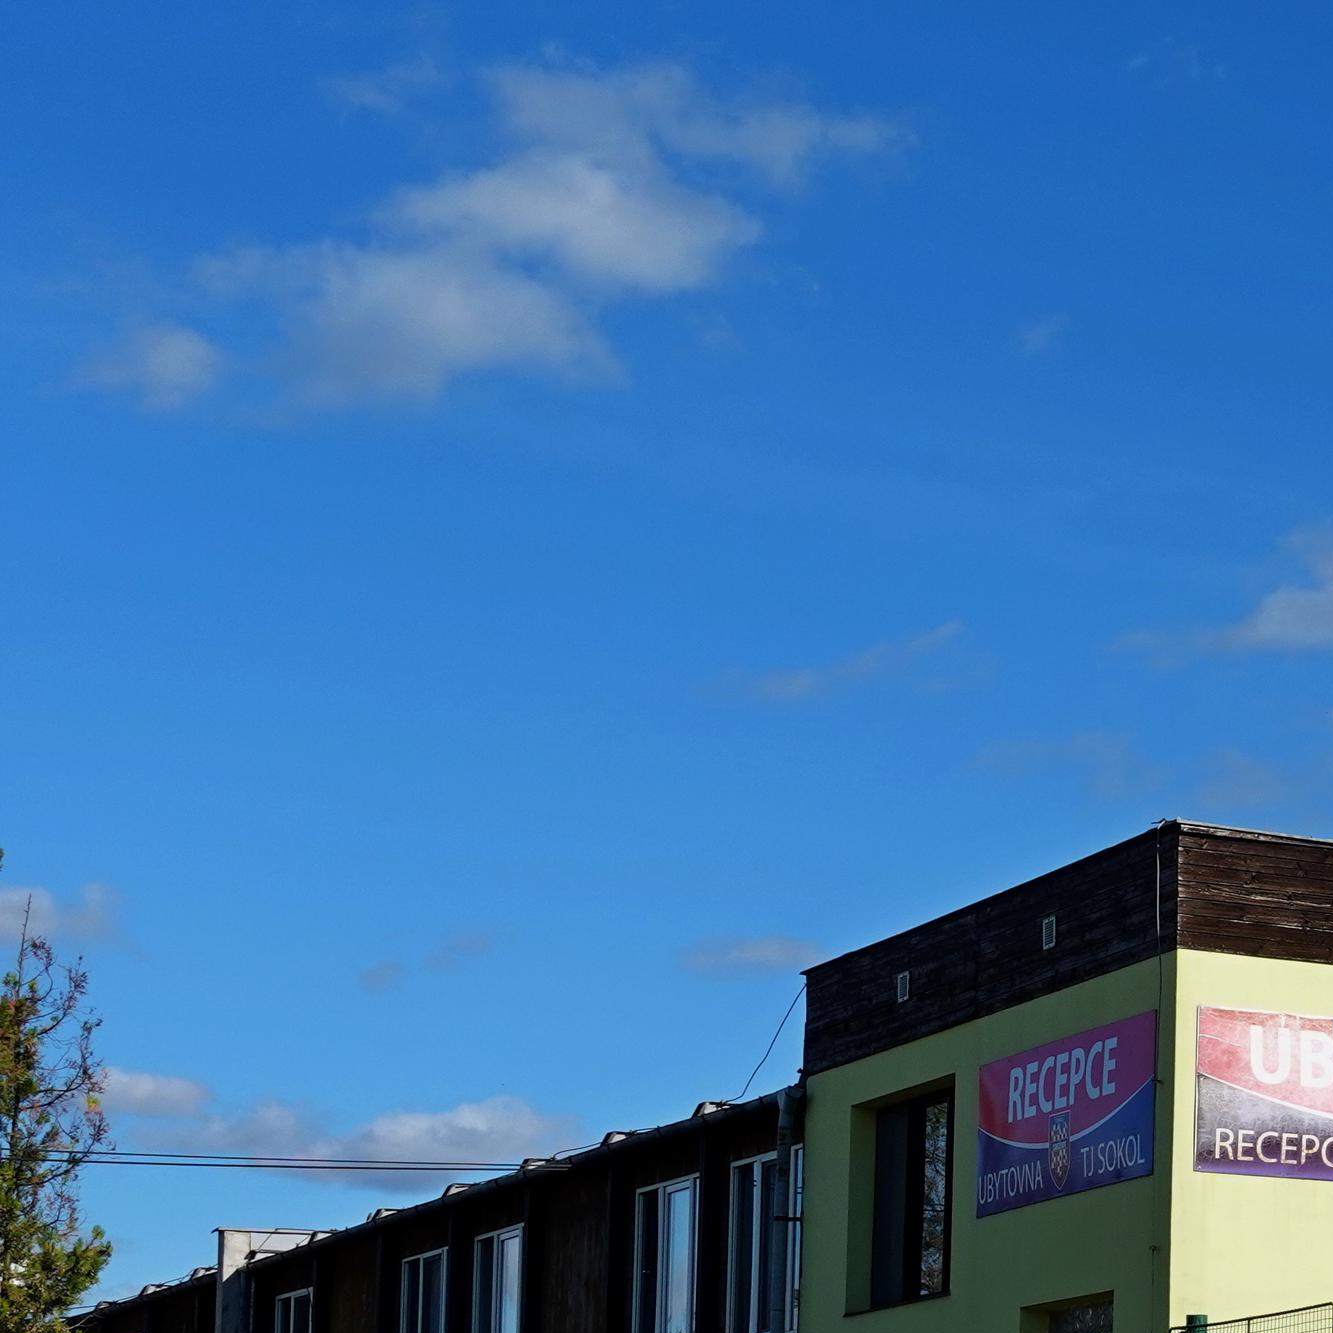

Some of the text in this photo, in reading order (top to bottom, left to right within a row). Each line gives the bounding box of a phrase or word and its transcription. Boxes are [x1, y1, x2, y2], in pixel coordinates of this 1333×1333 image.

[1008, 1036, 1118, 1123] RECEPCE
[1080, 1134, 1145, 1178] TJ SOKOL
[977, 1159, 1044, 1205] UBYTOVNA
